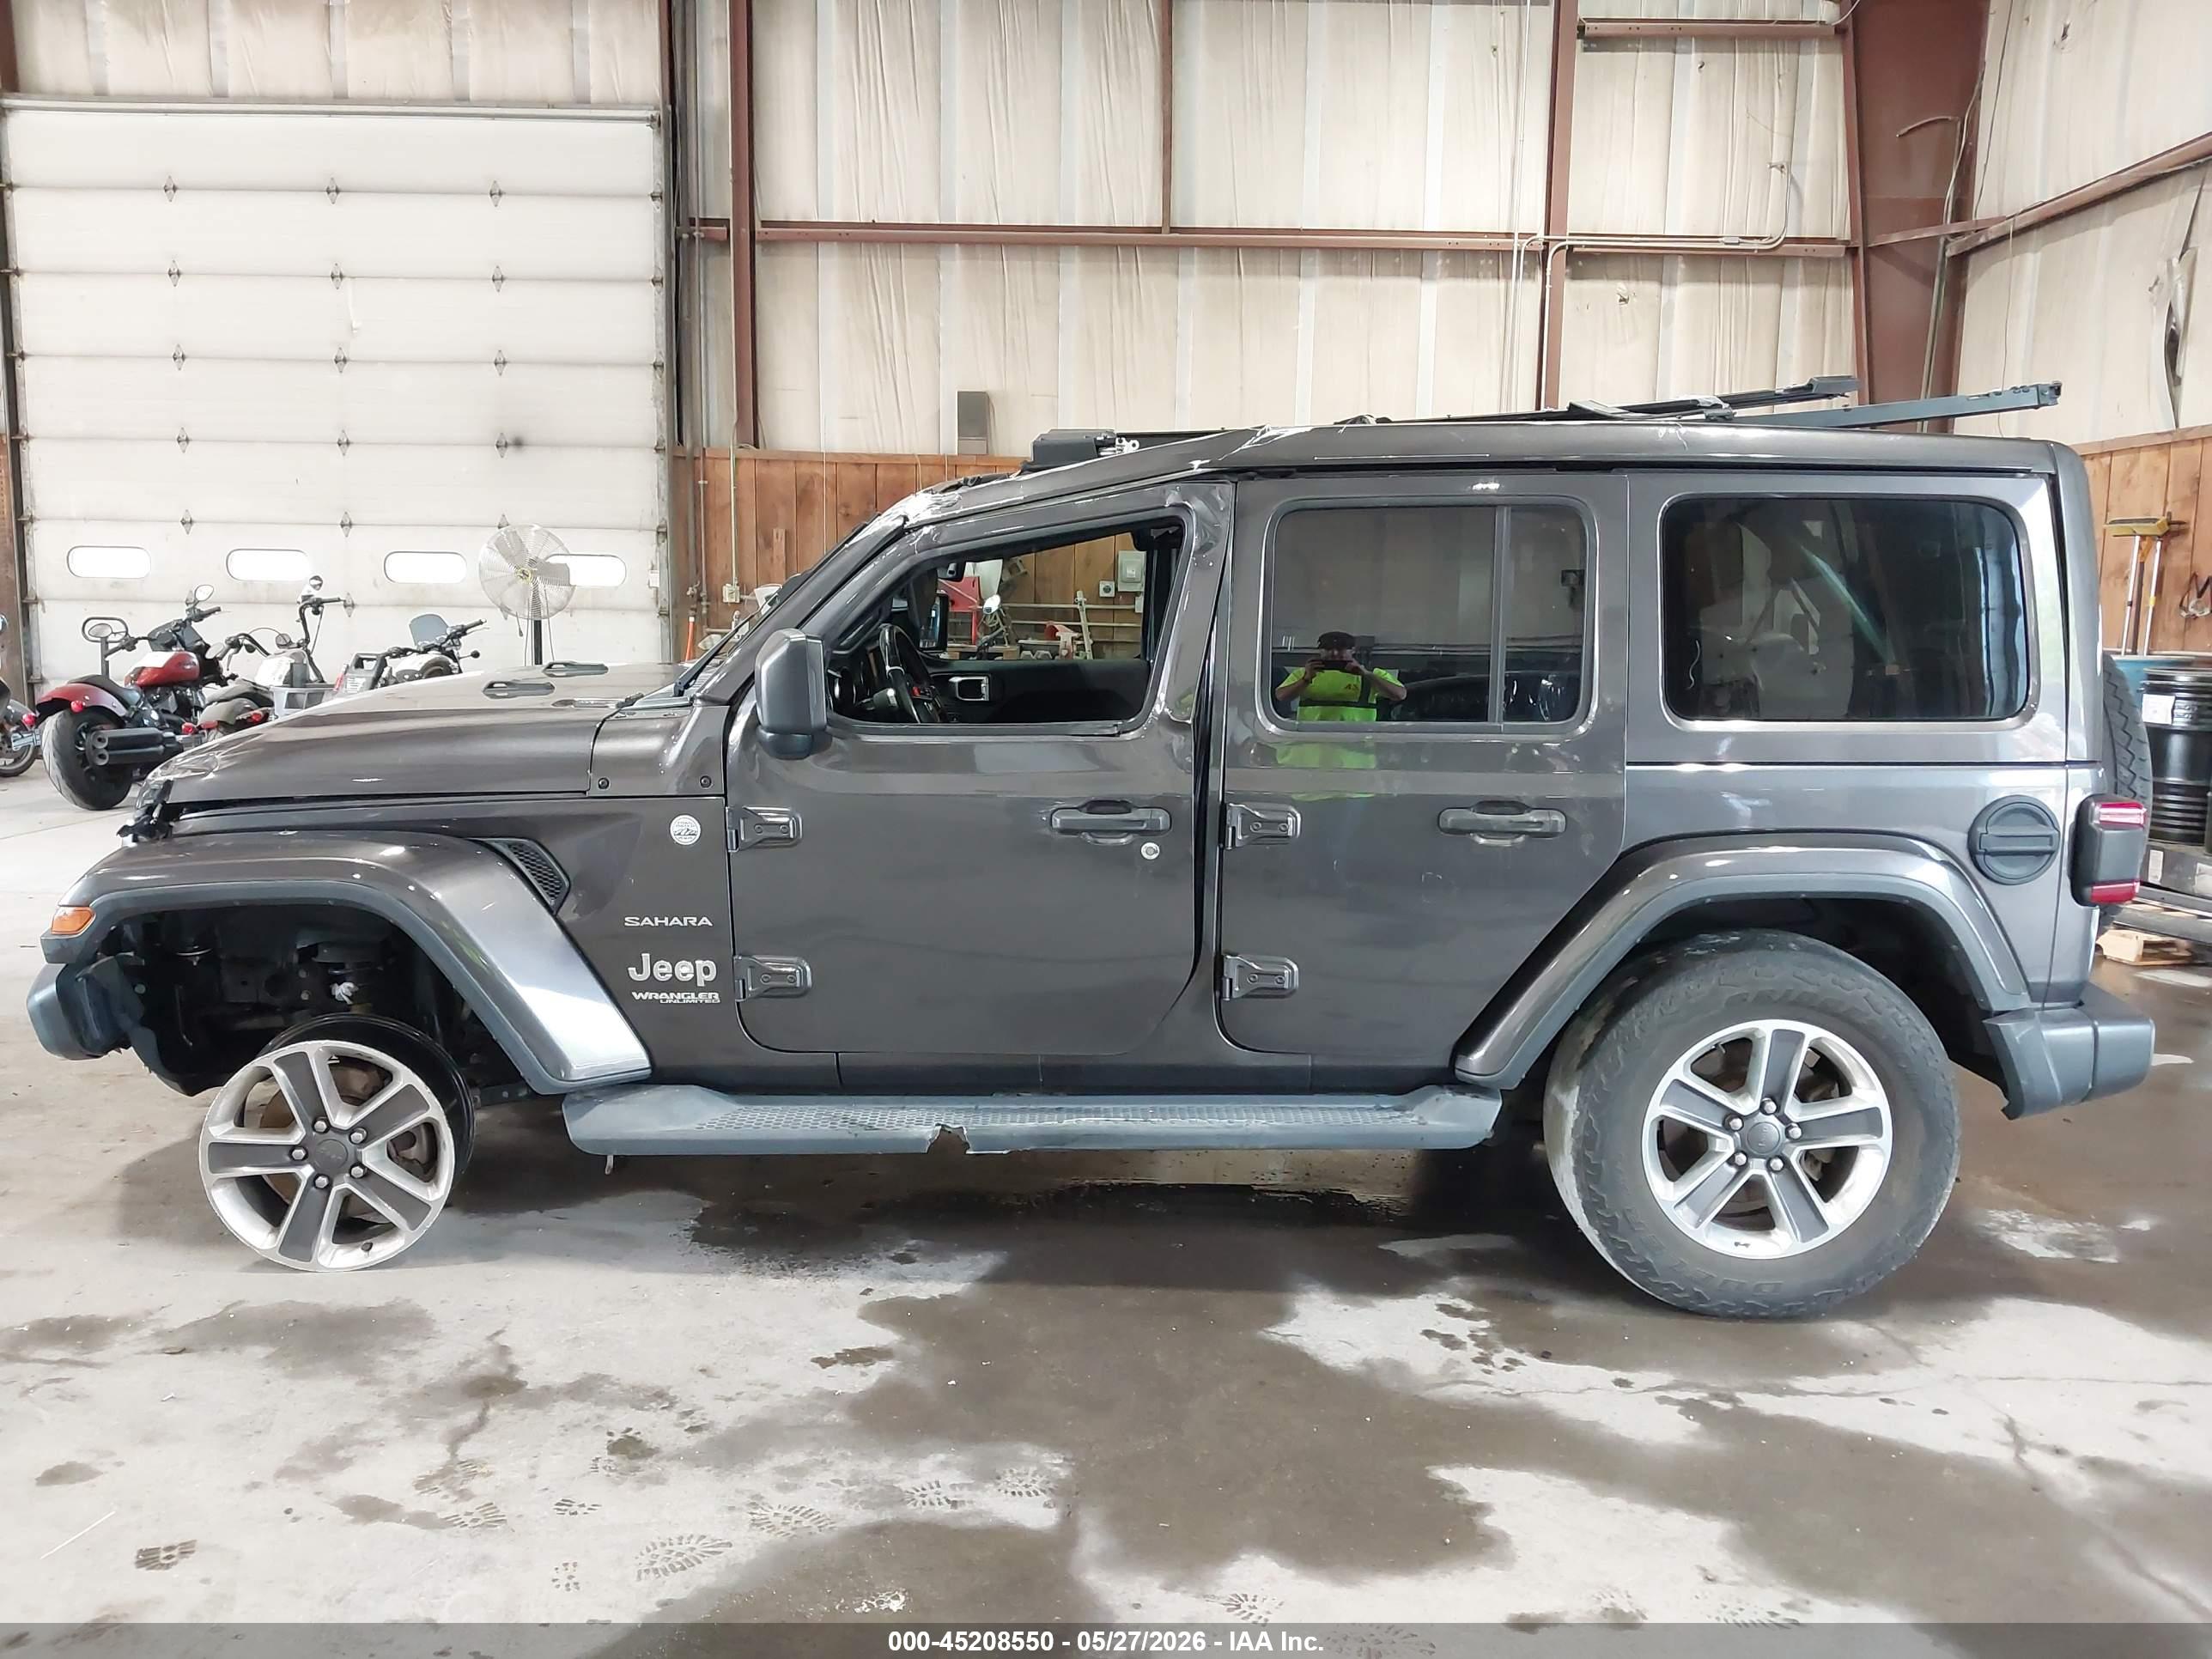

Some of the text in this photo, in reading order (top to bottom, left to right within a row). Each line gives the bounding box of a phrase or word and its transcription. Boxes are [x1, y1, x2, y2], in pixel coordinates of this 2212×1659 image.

[624, 916, 714, 927] SAHARA
[627, 952, 717, 988] Jeep
[631, 991, 720, 1000] WRANGLER
